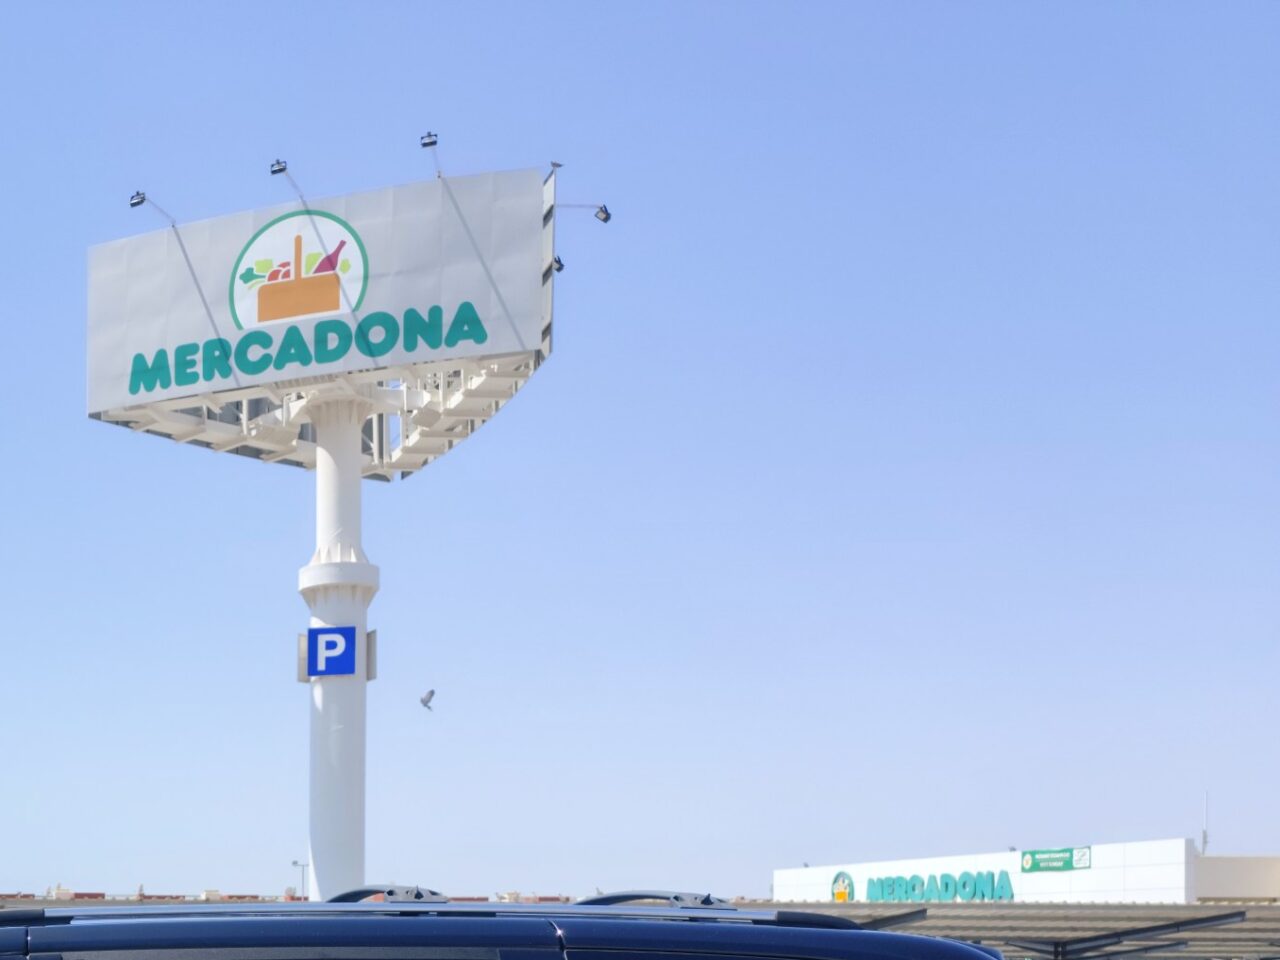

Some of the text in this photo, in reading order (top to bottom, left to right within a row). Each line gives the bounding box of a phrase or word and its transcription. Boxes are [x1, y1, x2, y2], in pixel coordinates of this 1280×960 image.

[129, 301, 488, 395] MERCADONA
[317, 633, 346, 671] P
[867, 870, 1014, 902] MERCADONA
